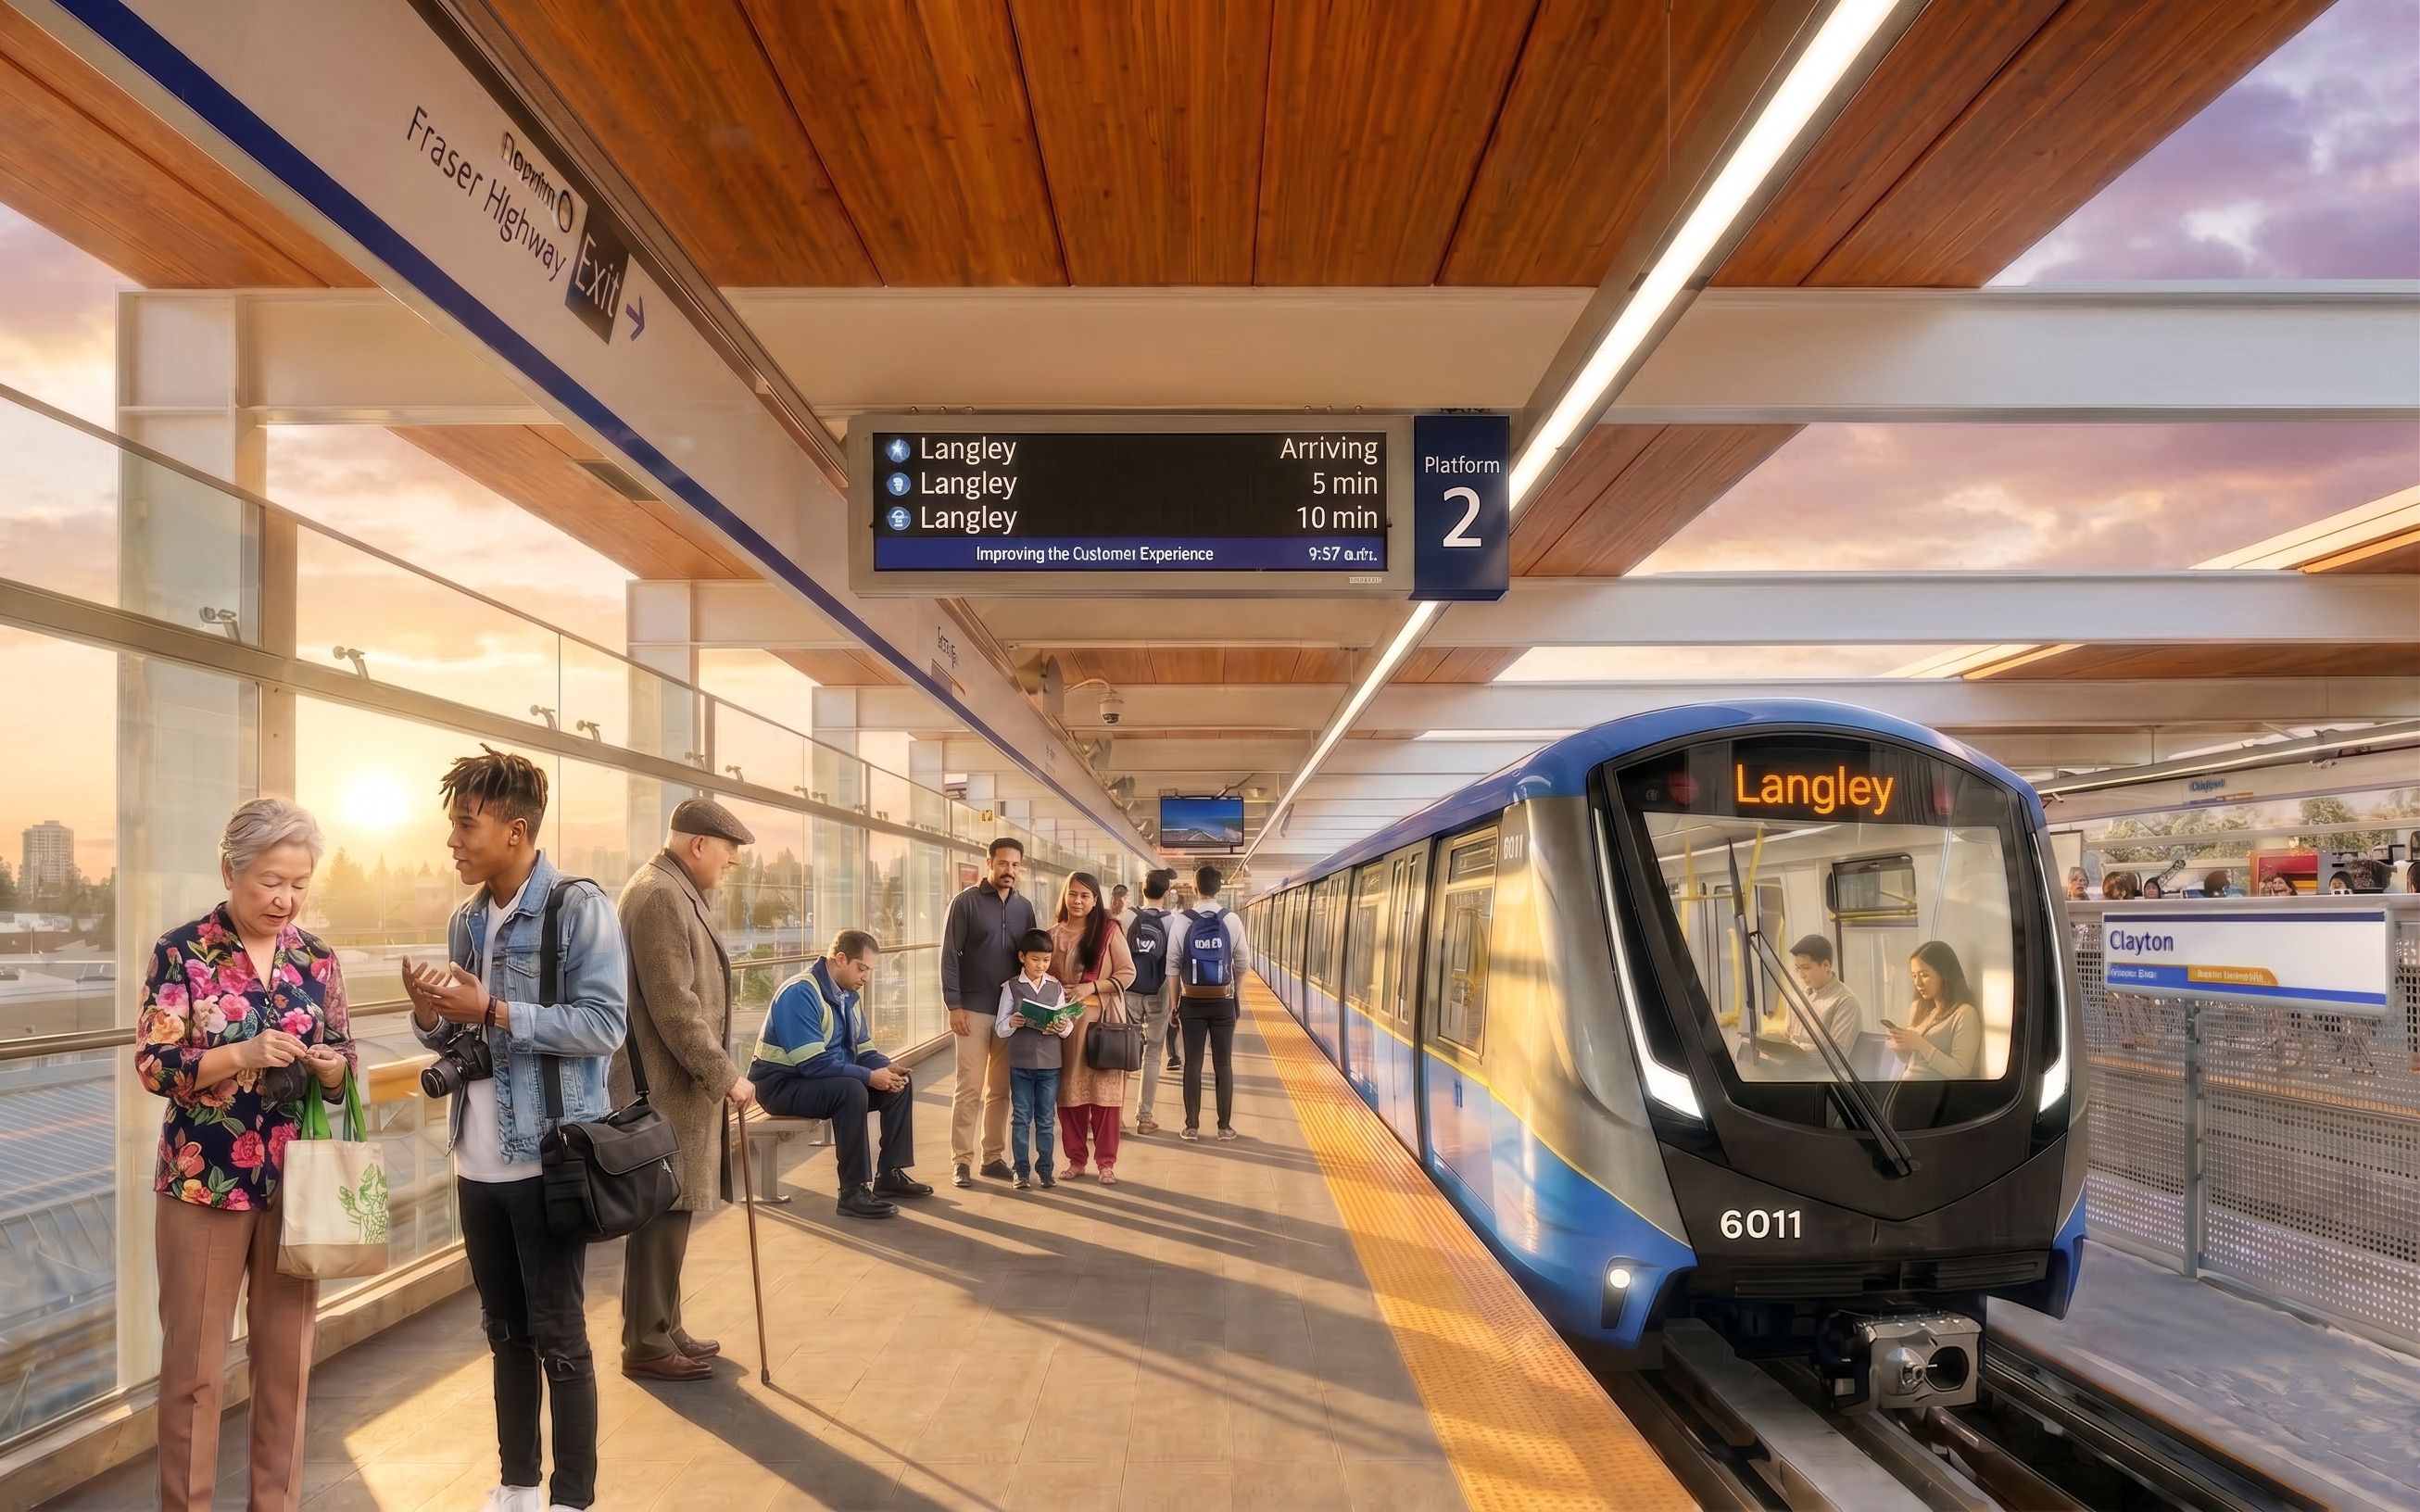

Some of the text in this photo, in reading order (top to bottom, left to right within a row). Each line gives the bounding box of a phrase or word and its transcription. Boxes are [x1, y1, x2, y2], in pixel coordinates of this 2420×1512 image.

[406, 105, 484, 197] Fraser
[574, 232, 620, 318] Exit
[921, 436, 1378, 465] Langley Arriving
[1425, 456, 1500, 473] Platform
[921, 471, 1378, 499] Langley 5 min
[921, 505, 1378, 535] Langley 10 min
[1443, 486, 1481, 548] 2
[977, 547, 1214, 564] Improving the Customer Experience
[1737, 764, 1894, 815] Langley
[2110, 929, 2174, 956] Clayton
[1720, 1209, 1801, 1240] 6011
